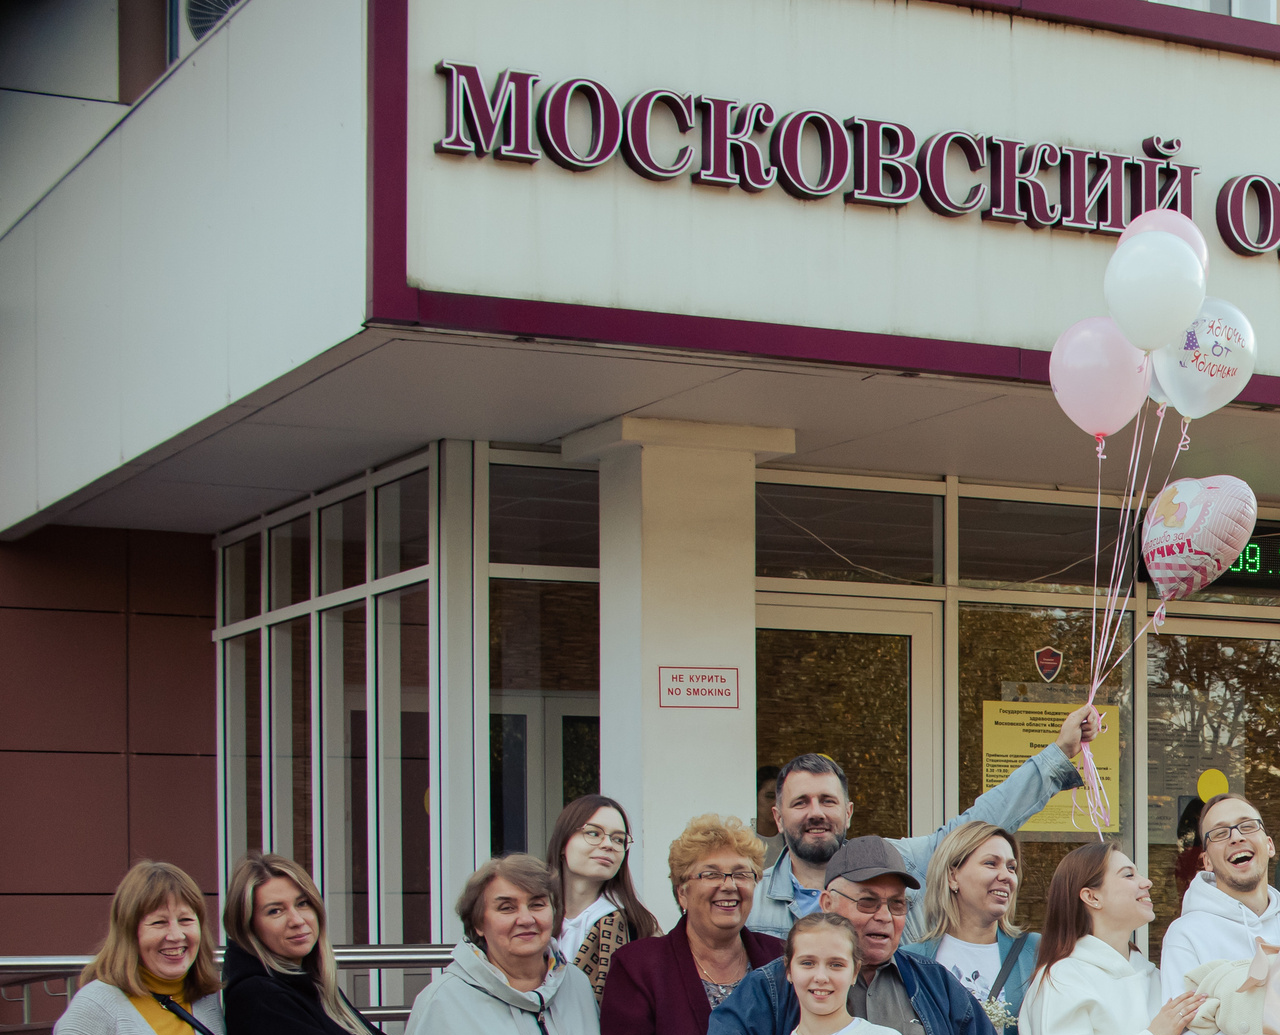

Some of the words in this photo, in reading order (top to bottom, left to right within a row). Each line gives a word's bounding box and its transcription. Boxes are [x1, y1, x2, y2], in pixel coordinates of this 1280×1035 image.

[435, 59, 1201, 236] МОСКОВСКИЙ
[671, 674, 684, 683] НЕ
[689, 674, 727, 684] КУРИТЬ
[667, 687, 682, 696] NO
[686, 687, 731, 697] SMOKING
